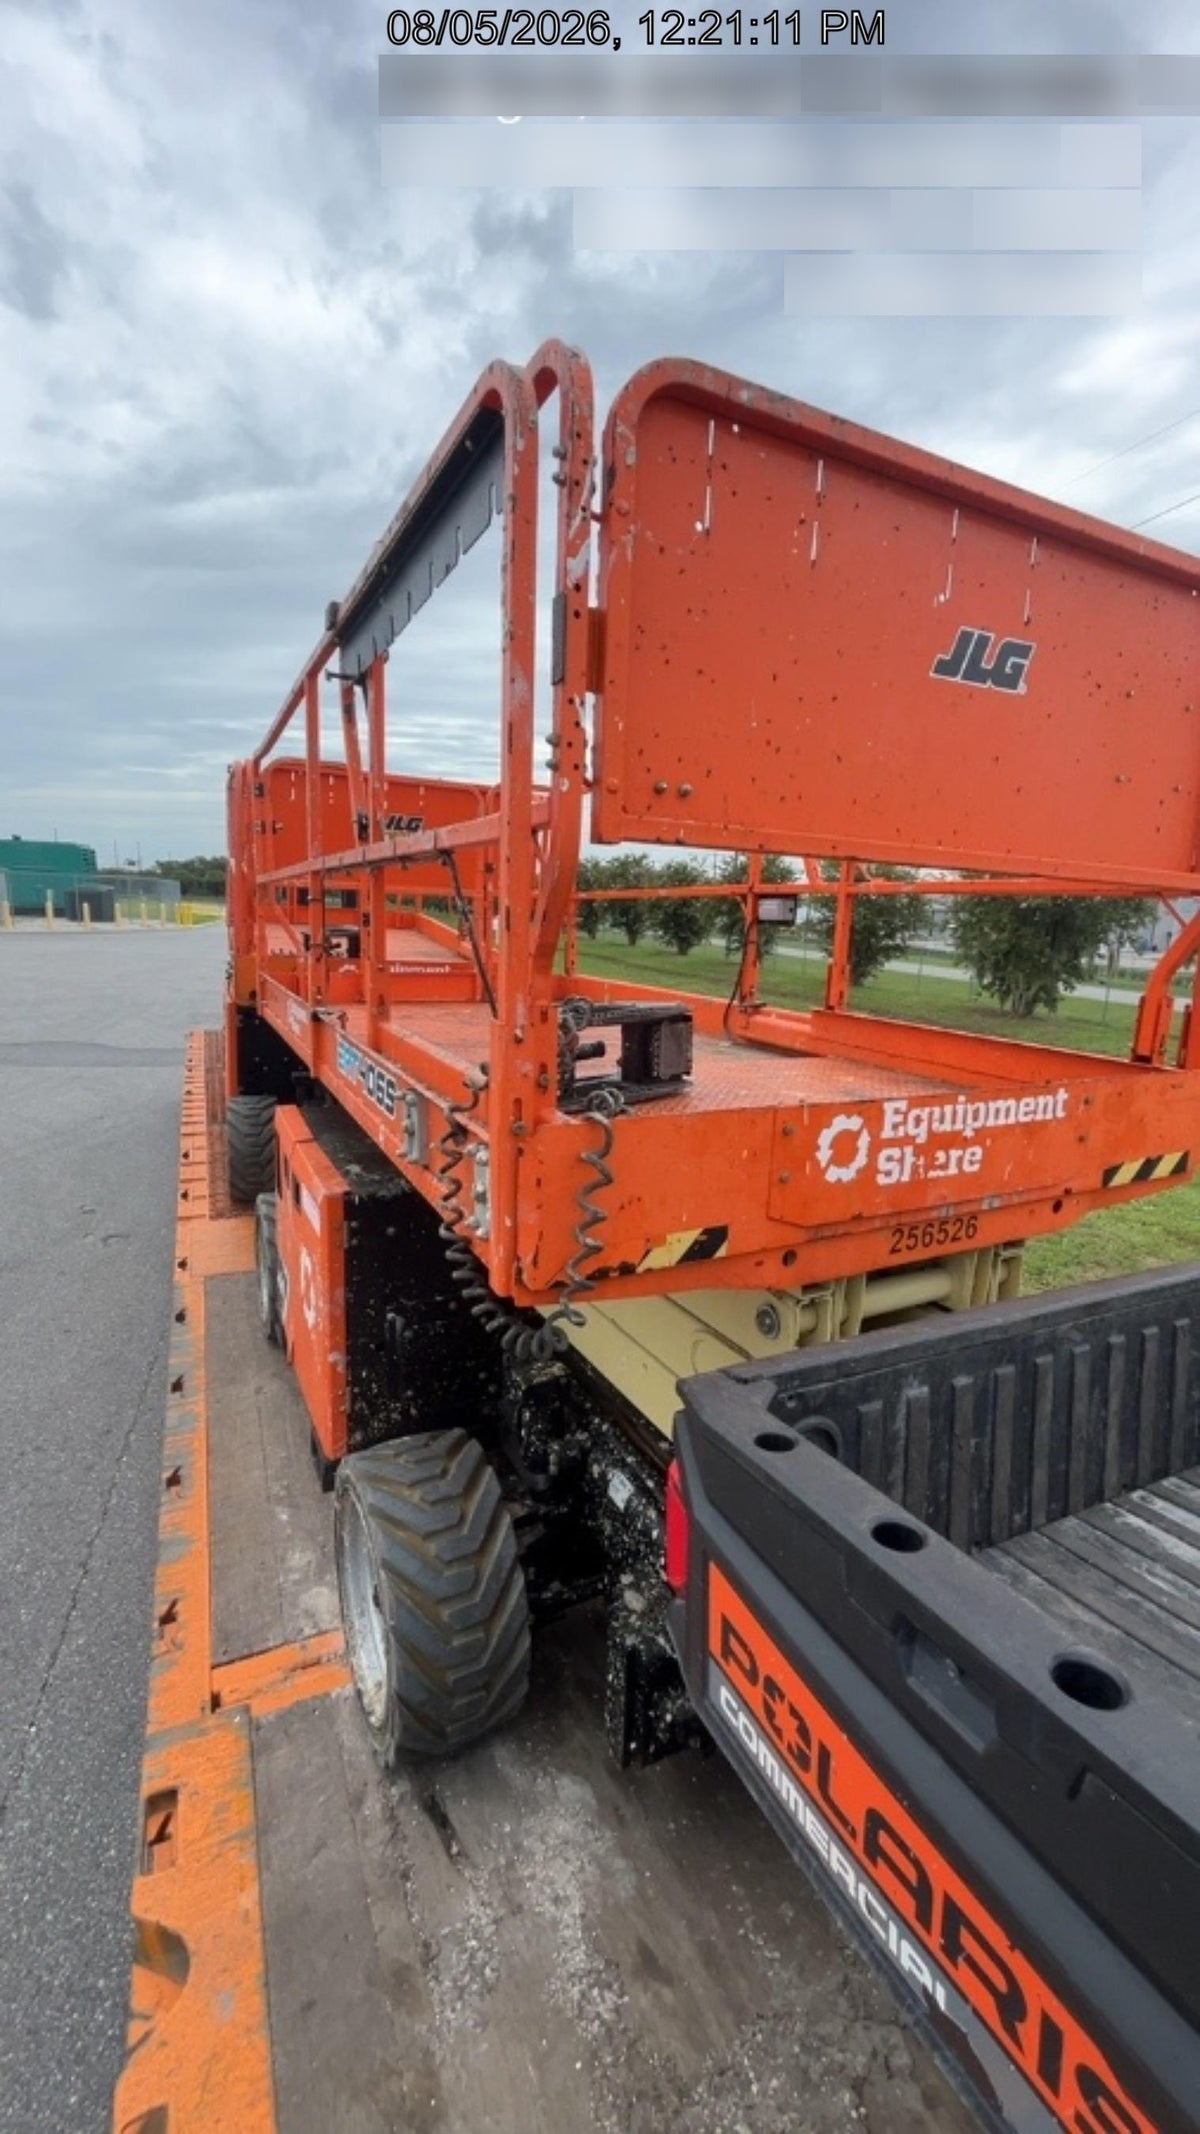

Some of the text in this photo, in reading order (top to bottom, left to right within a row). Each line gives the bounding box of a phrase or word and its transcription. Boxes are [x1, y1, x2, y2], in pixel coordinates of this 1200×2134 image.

[930, 626, 1036, 694] JLG
[880, 1087, 1068, 1143] Equipment
[889, 1215, 978, 1254] 256526
